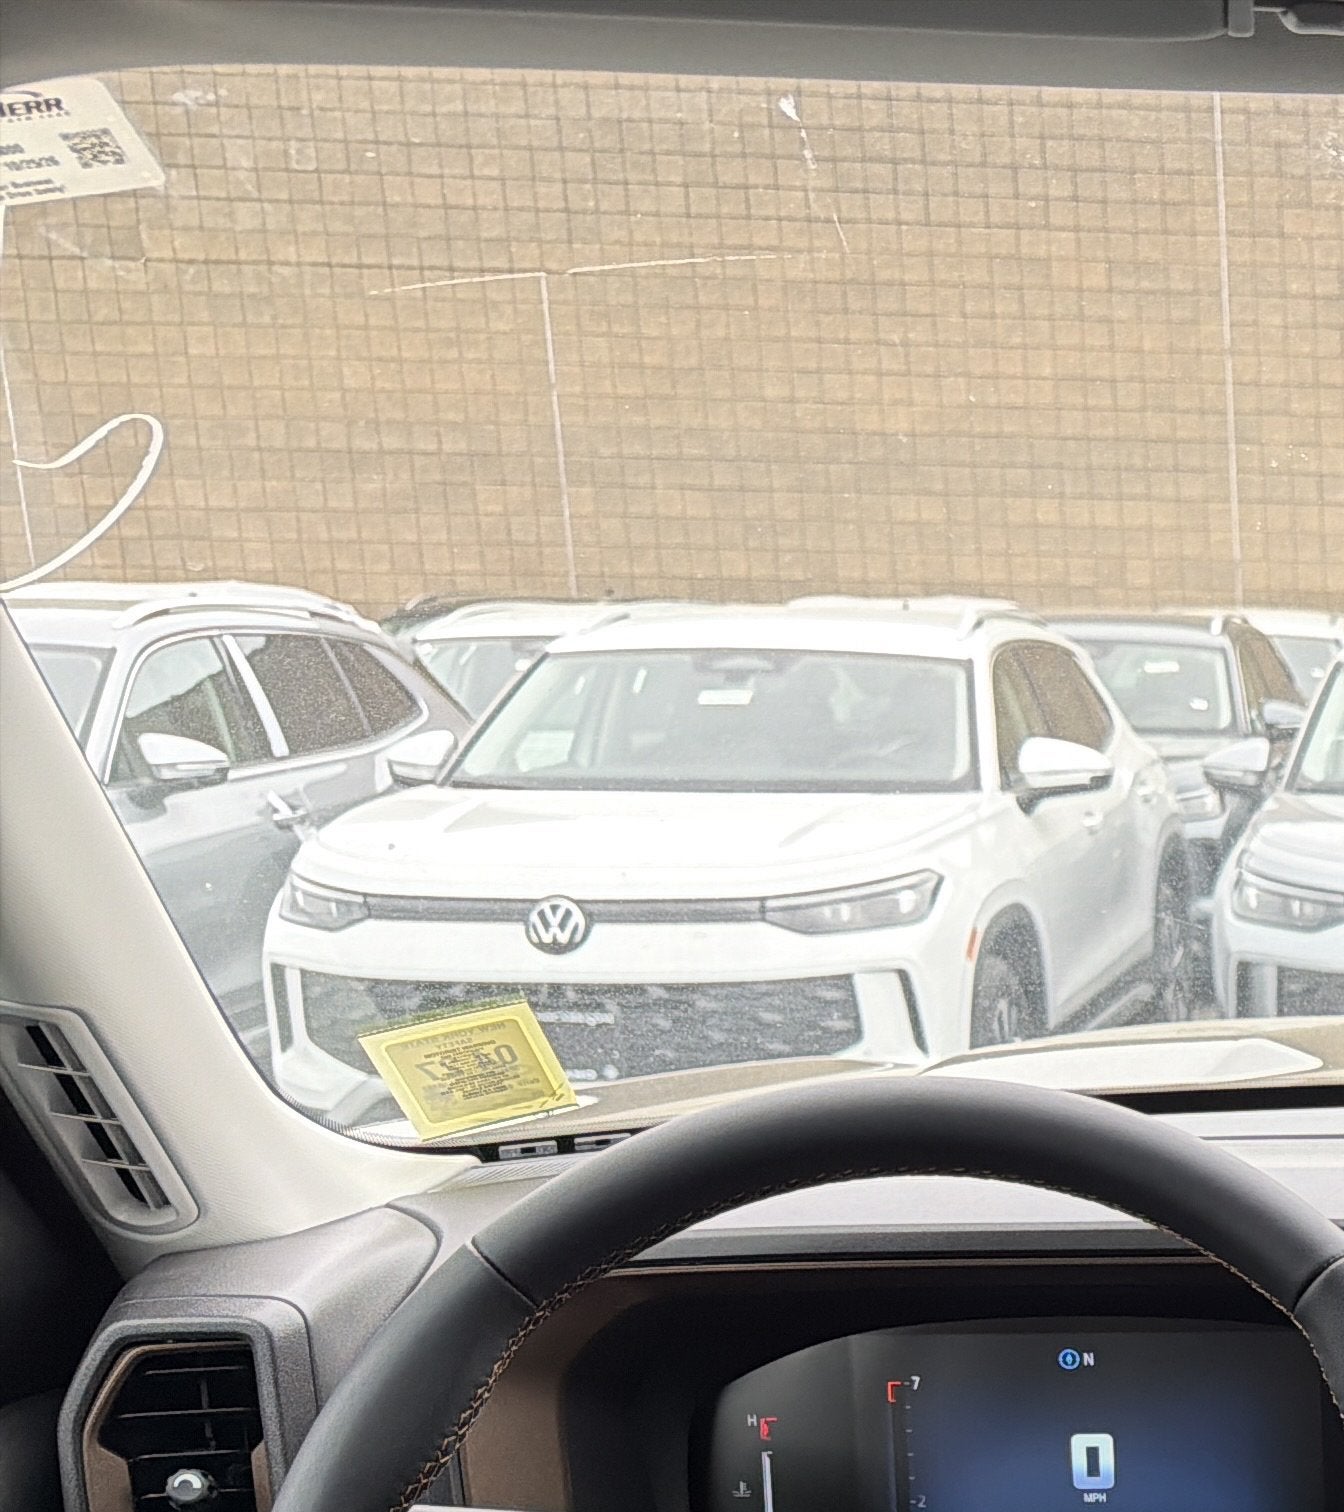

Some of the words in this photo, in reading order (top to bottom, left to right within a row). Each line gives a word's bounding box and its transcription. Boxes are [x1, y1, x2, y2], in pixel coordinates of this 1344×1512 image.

[1082, 1352, 1095, 1366] N
[911, 1376, 920, 1390] 7
[747, 1414, 757, 1427] H
[1071, 1433, 1115, 1489] 0
[917, 1495, 926, 1508] 2
[1083, 1493, 1107, 1503] MPH
